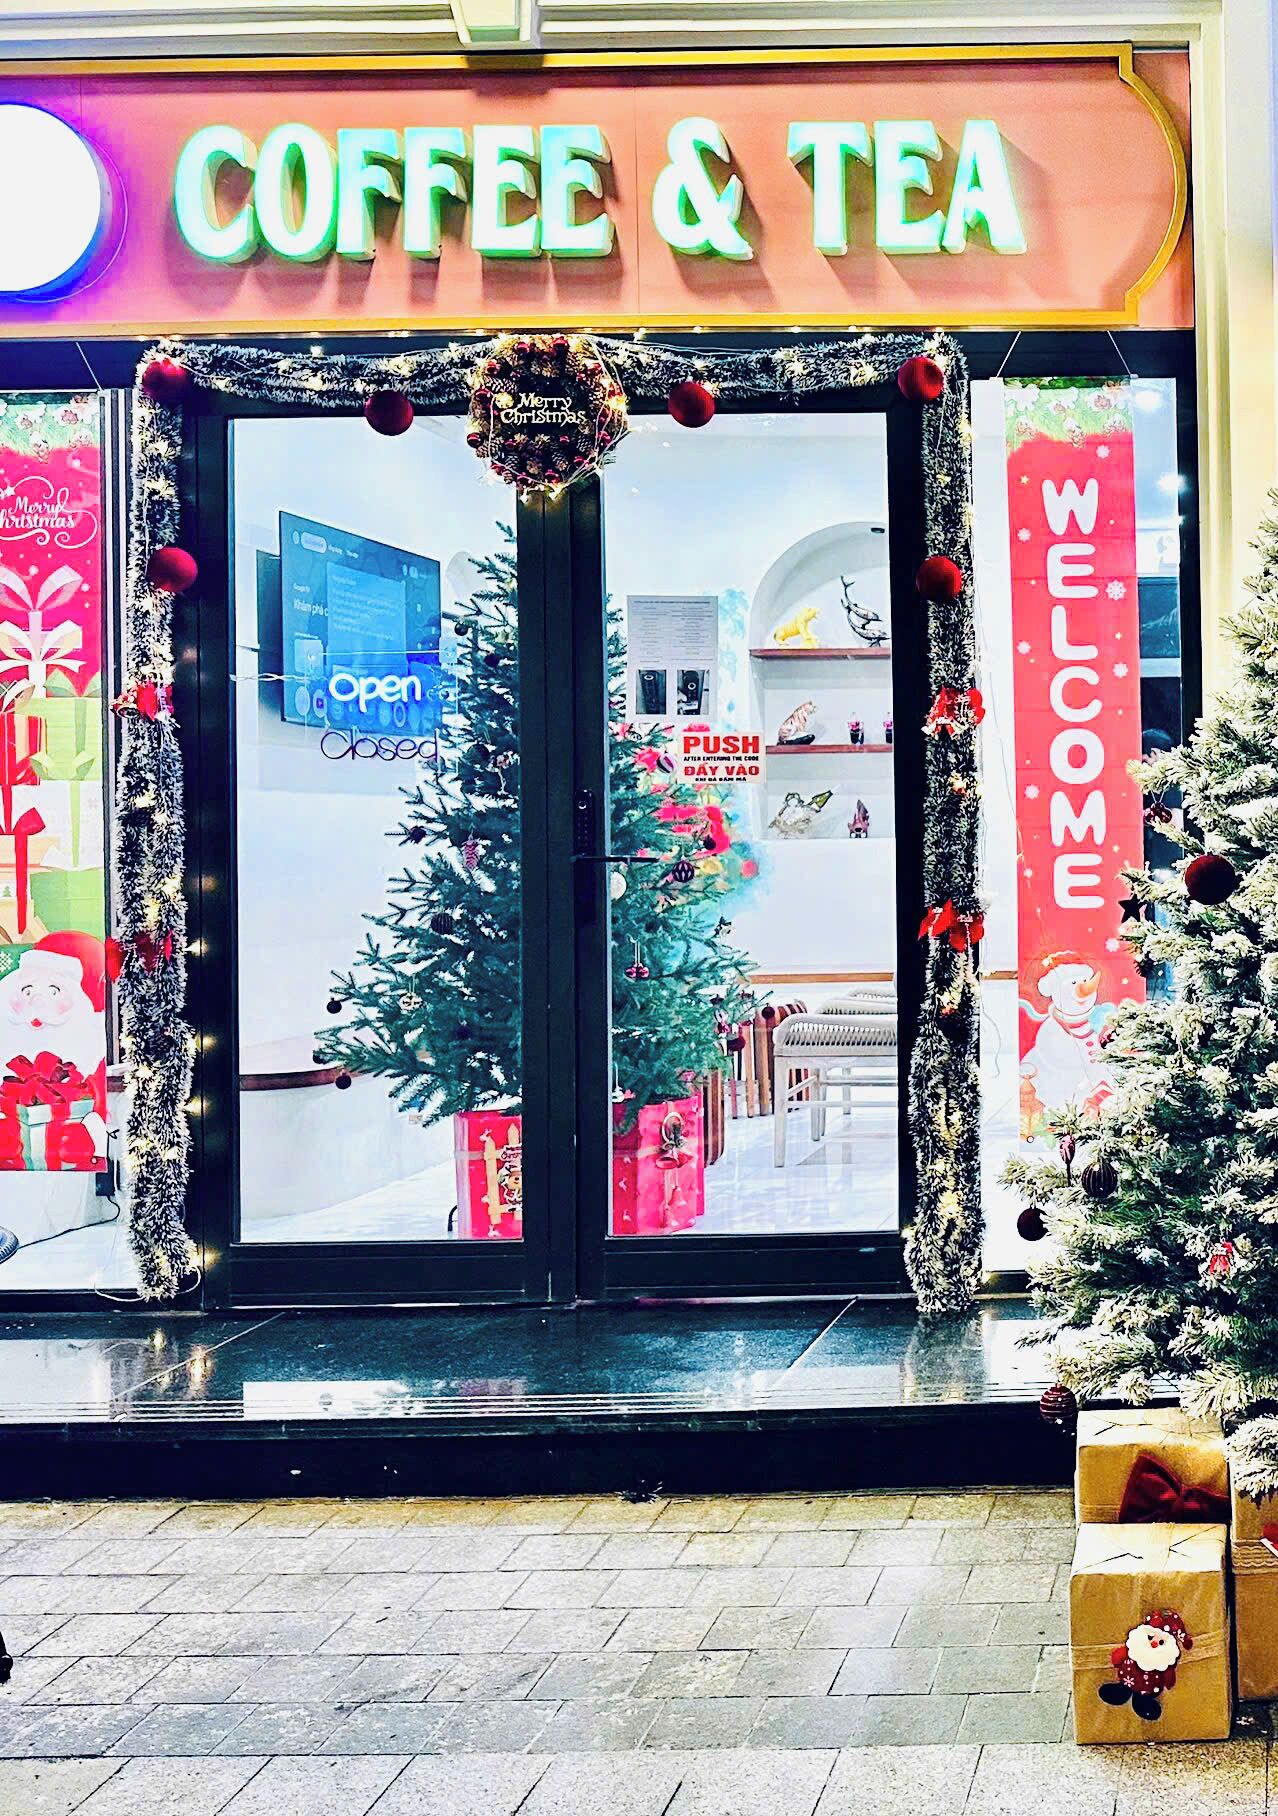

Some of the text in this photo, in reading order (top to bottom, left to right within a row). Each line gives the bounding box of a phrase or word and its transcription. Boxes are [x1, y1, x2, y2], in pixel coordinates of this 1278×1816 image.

[175, 116, 1028, 263] COFFEE & TEA
[516, 392, 572, 411] Merry
[500, 408, 586, 426] Christmas
[11, 491, 67, 518] Merry
[0, 508, 76, 529] hristmas
[329, 672, 422, 713] Open
[1041, 477, 1106, 909] WELCOME
[321, 727, 439, 761] Closed
[683, 735, 760, 754] PUSH
